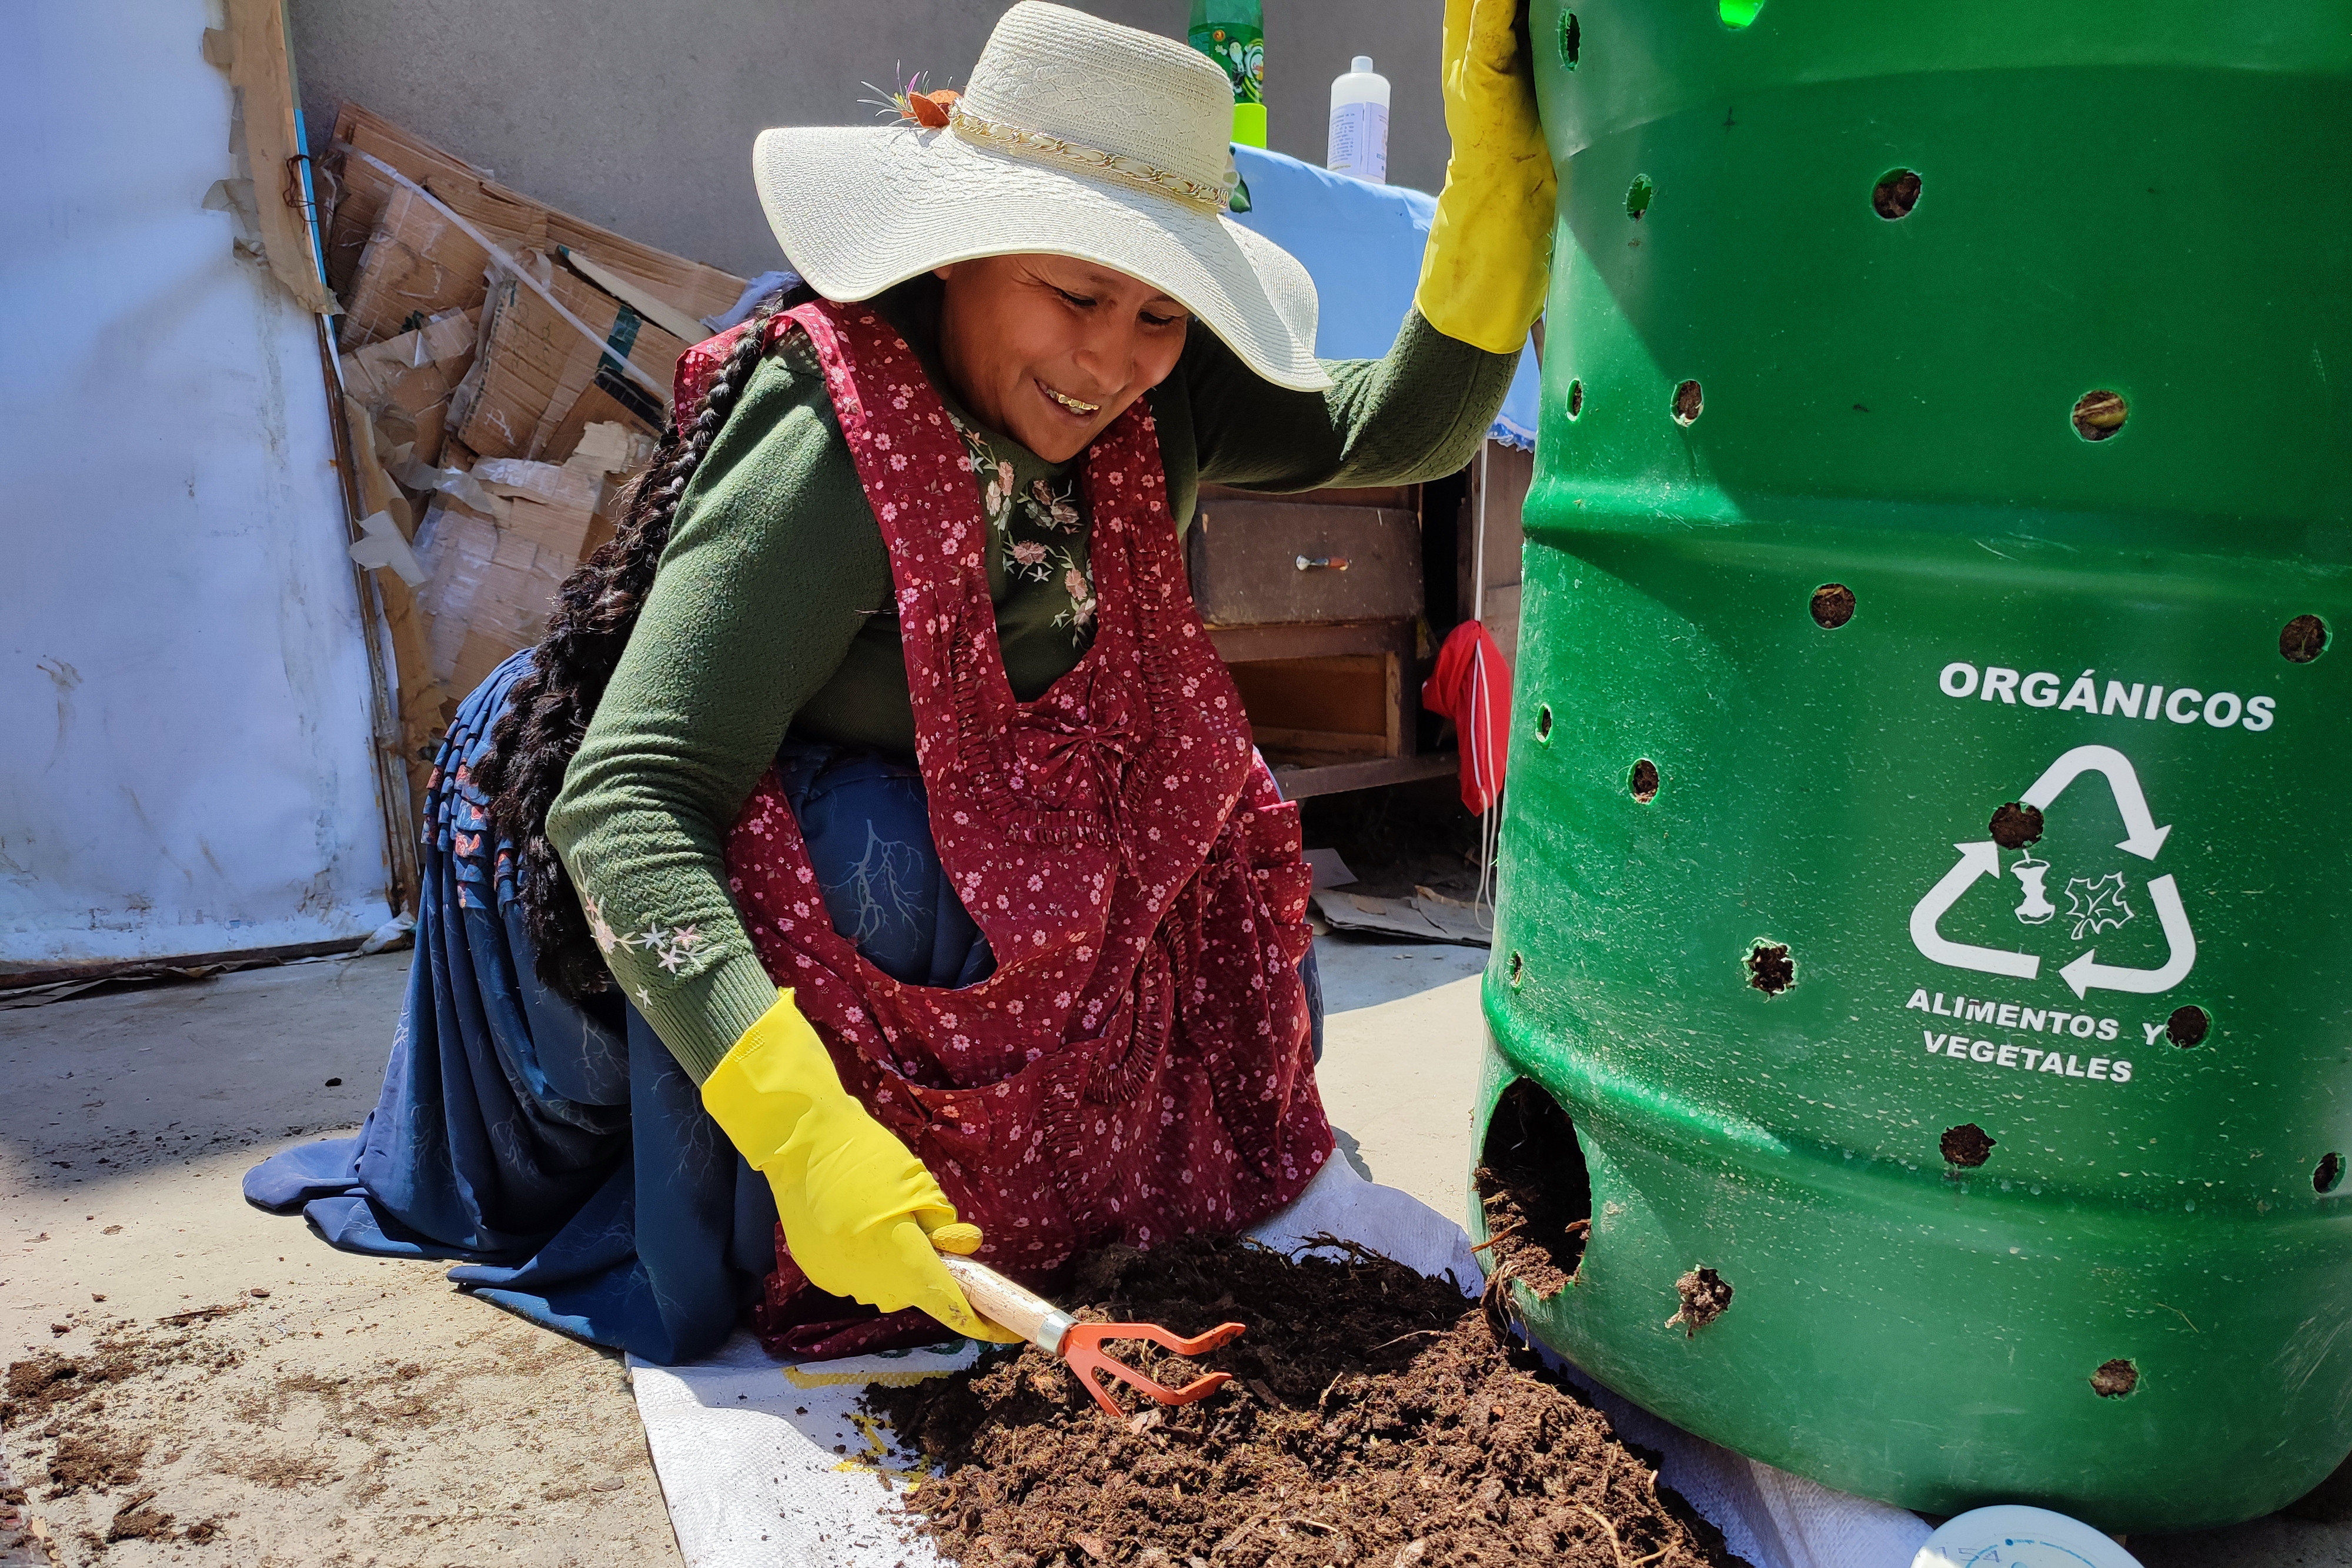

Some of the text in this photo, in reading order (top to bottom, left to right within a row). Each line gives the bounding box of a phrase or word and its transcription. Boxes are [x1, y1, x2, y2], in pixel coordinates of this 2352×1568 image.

[1939, 662, 2276, 731] ORGÁNICOS
[1905, 988, 2167, 1046] ALIMENTOS Y
[1923, 1030, 2133, 1083] VEGETALES
